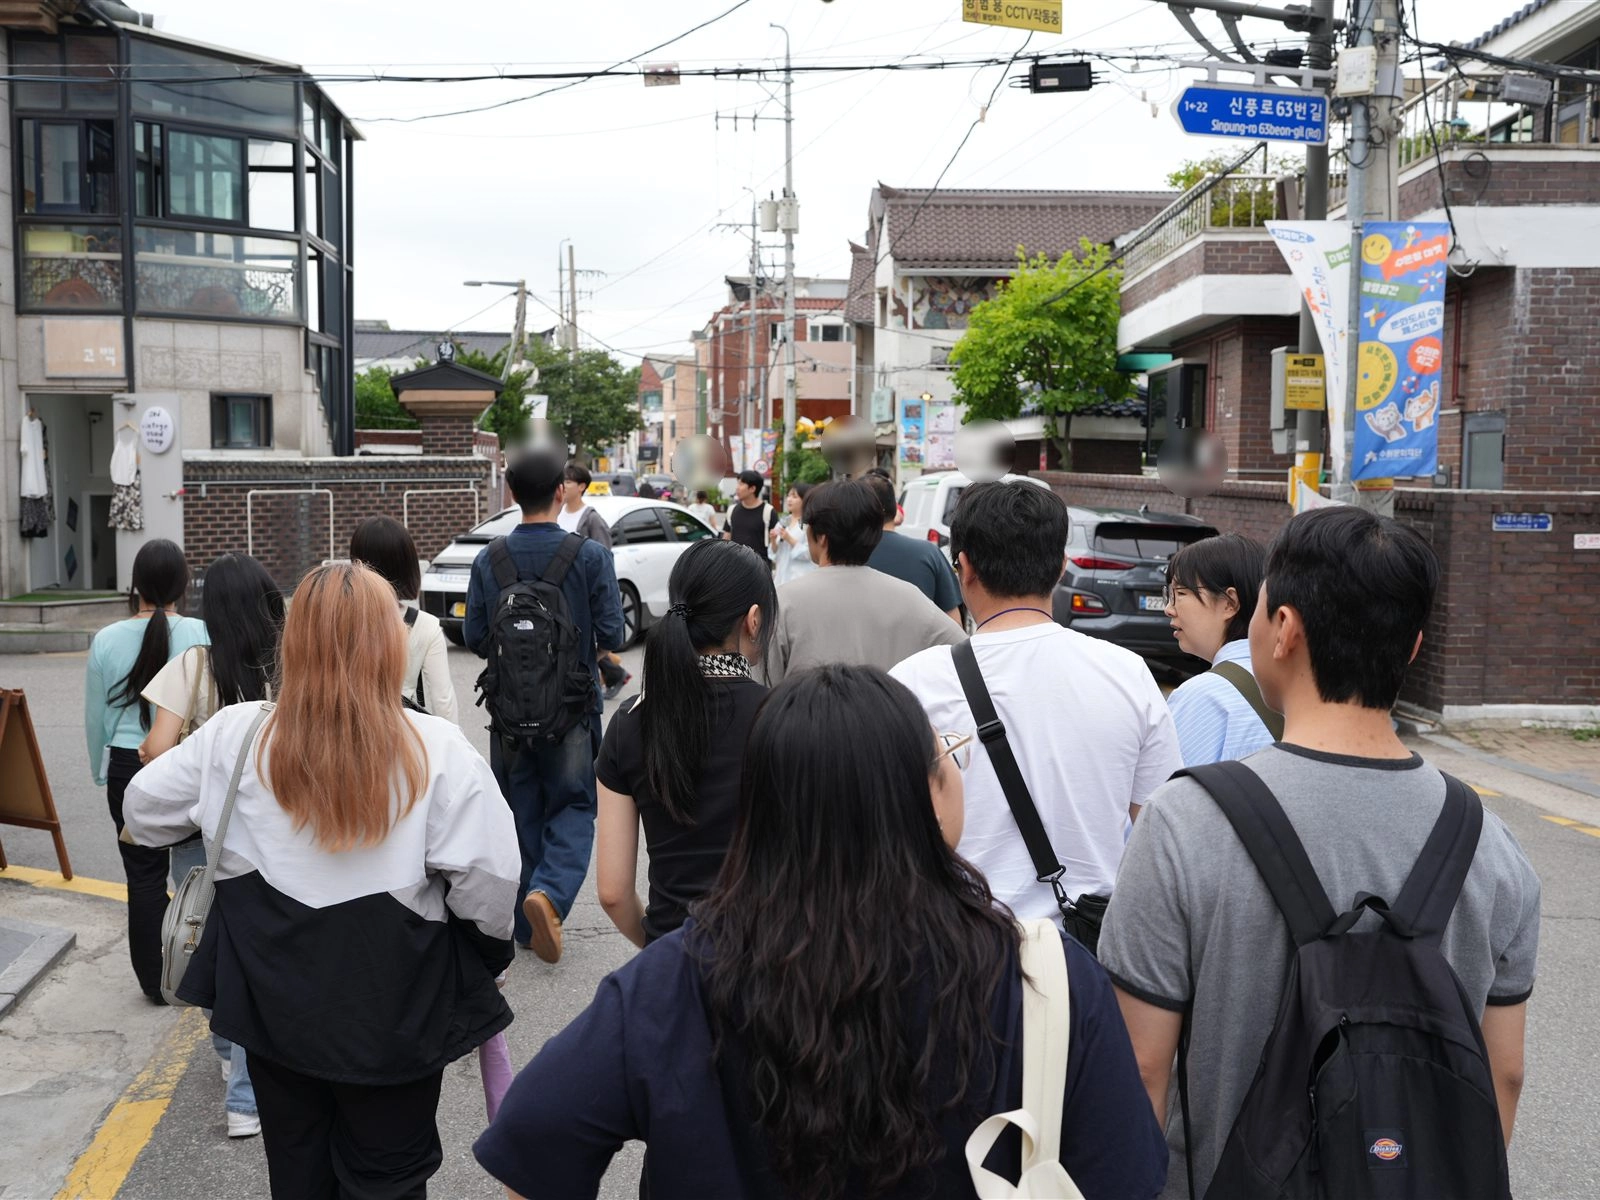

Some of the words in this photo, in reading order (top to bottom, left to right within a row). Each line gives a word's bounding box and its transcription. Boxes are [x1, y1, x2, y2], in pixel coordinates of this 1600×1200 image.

[1229, 97, 1323, 122] 신풍로63번길
[1211, 119, 1257, 135] Sinpung-ro
[1258, 123, 1305, 139] 63beon-gil
[1305, 128, 1321, 140] (Rd)
[83, 347, 116, 368] 고백
